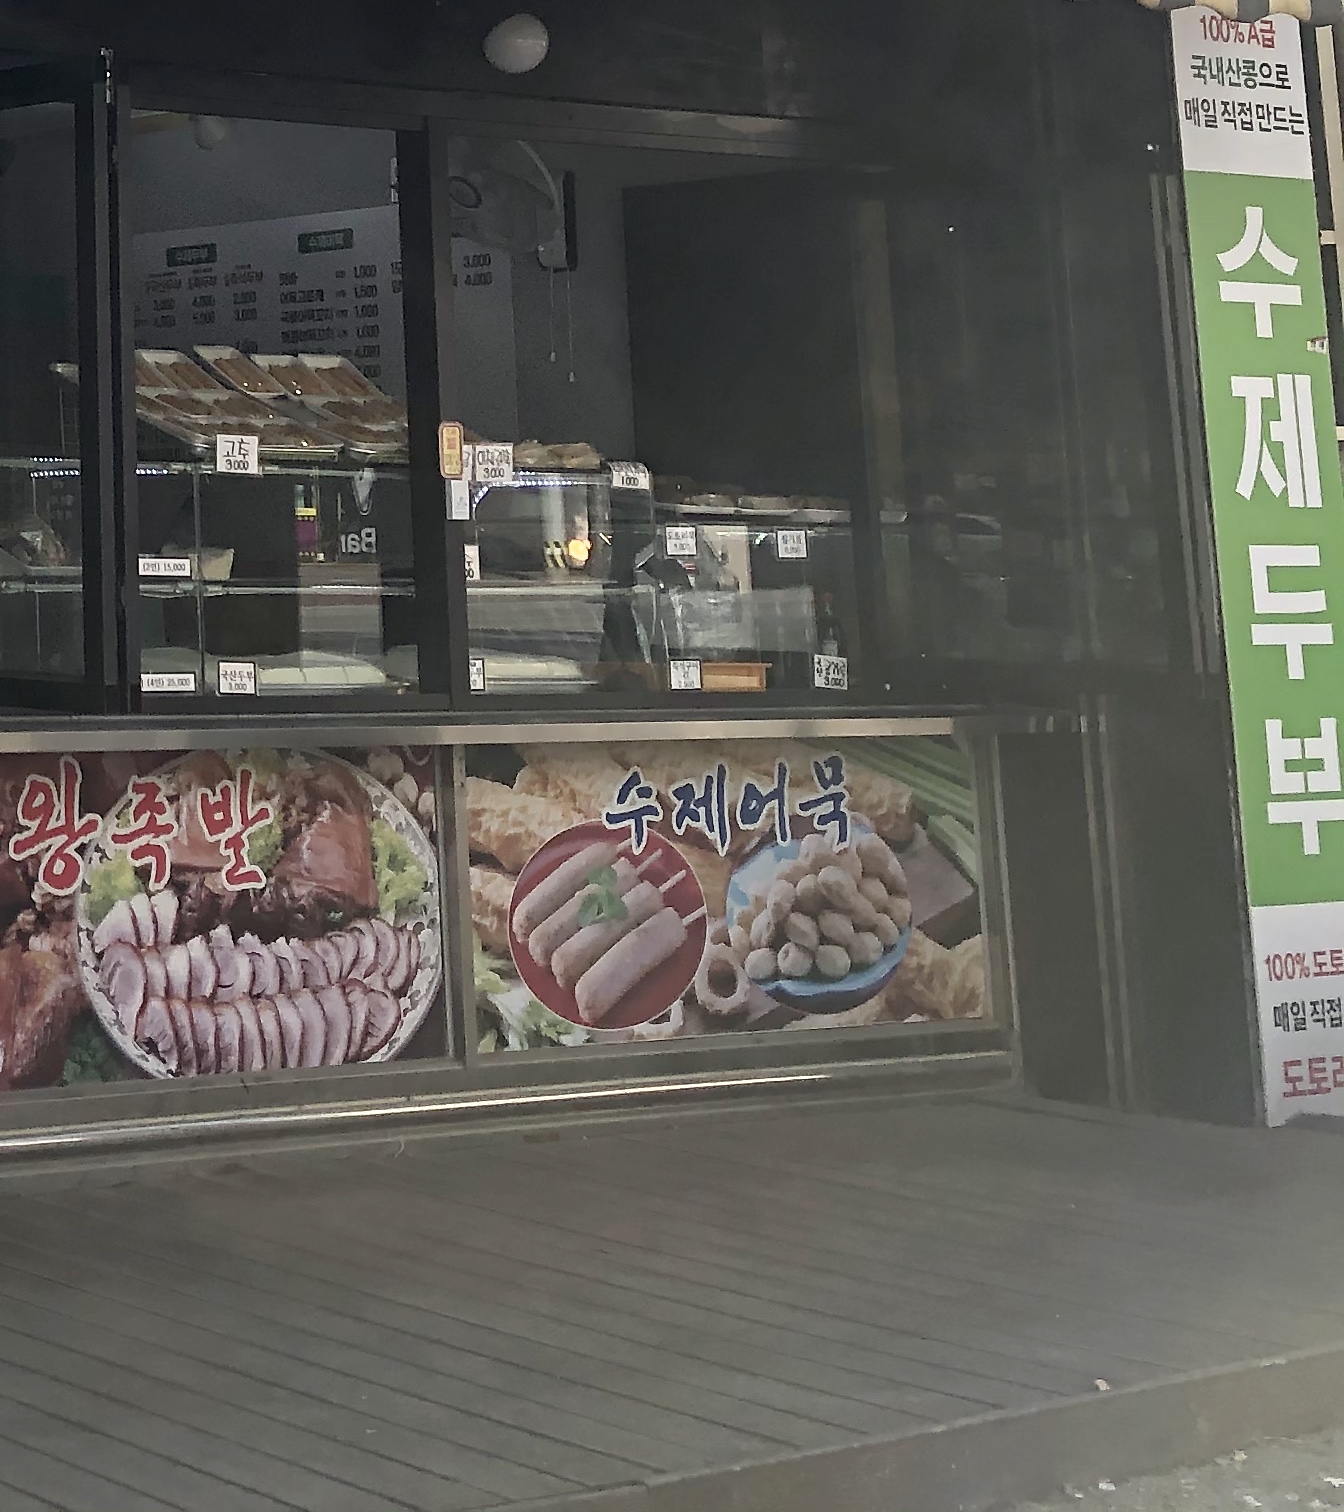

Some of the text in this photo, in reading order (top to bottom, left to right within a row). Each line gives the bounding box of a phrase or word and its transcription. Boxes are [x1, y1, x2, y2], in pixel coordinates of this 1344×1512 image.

[1200, 15, 1244, 43] 100%
[1190, 54, 1291, 89] 국내산콩으로
[1184, 98, 1304, 135] 매일 직접 만드는
[1216, 206, 1344, 857] 수제두부
[10, 754, 275, 895] 왕족발
[603, 754, 854, 859] 수제어묵
[1265, 953, 1311, 981] 100%
[1273, 997, 1342, 1032] 매일 직접
